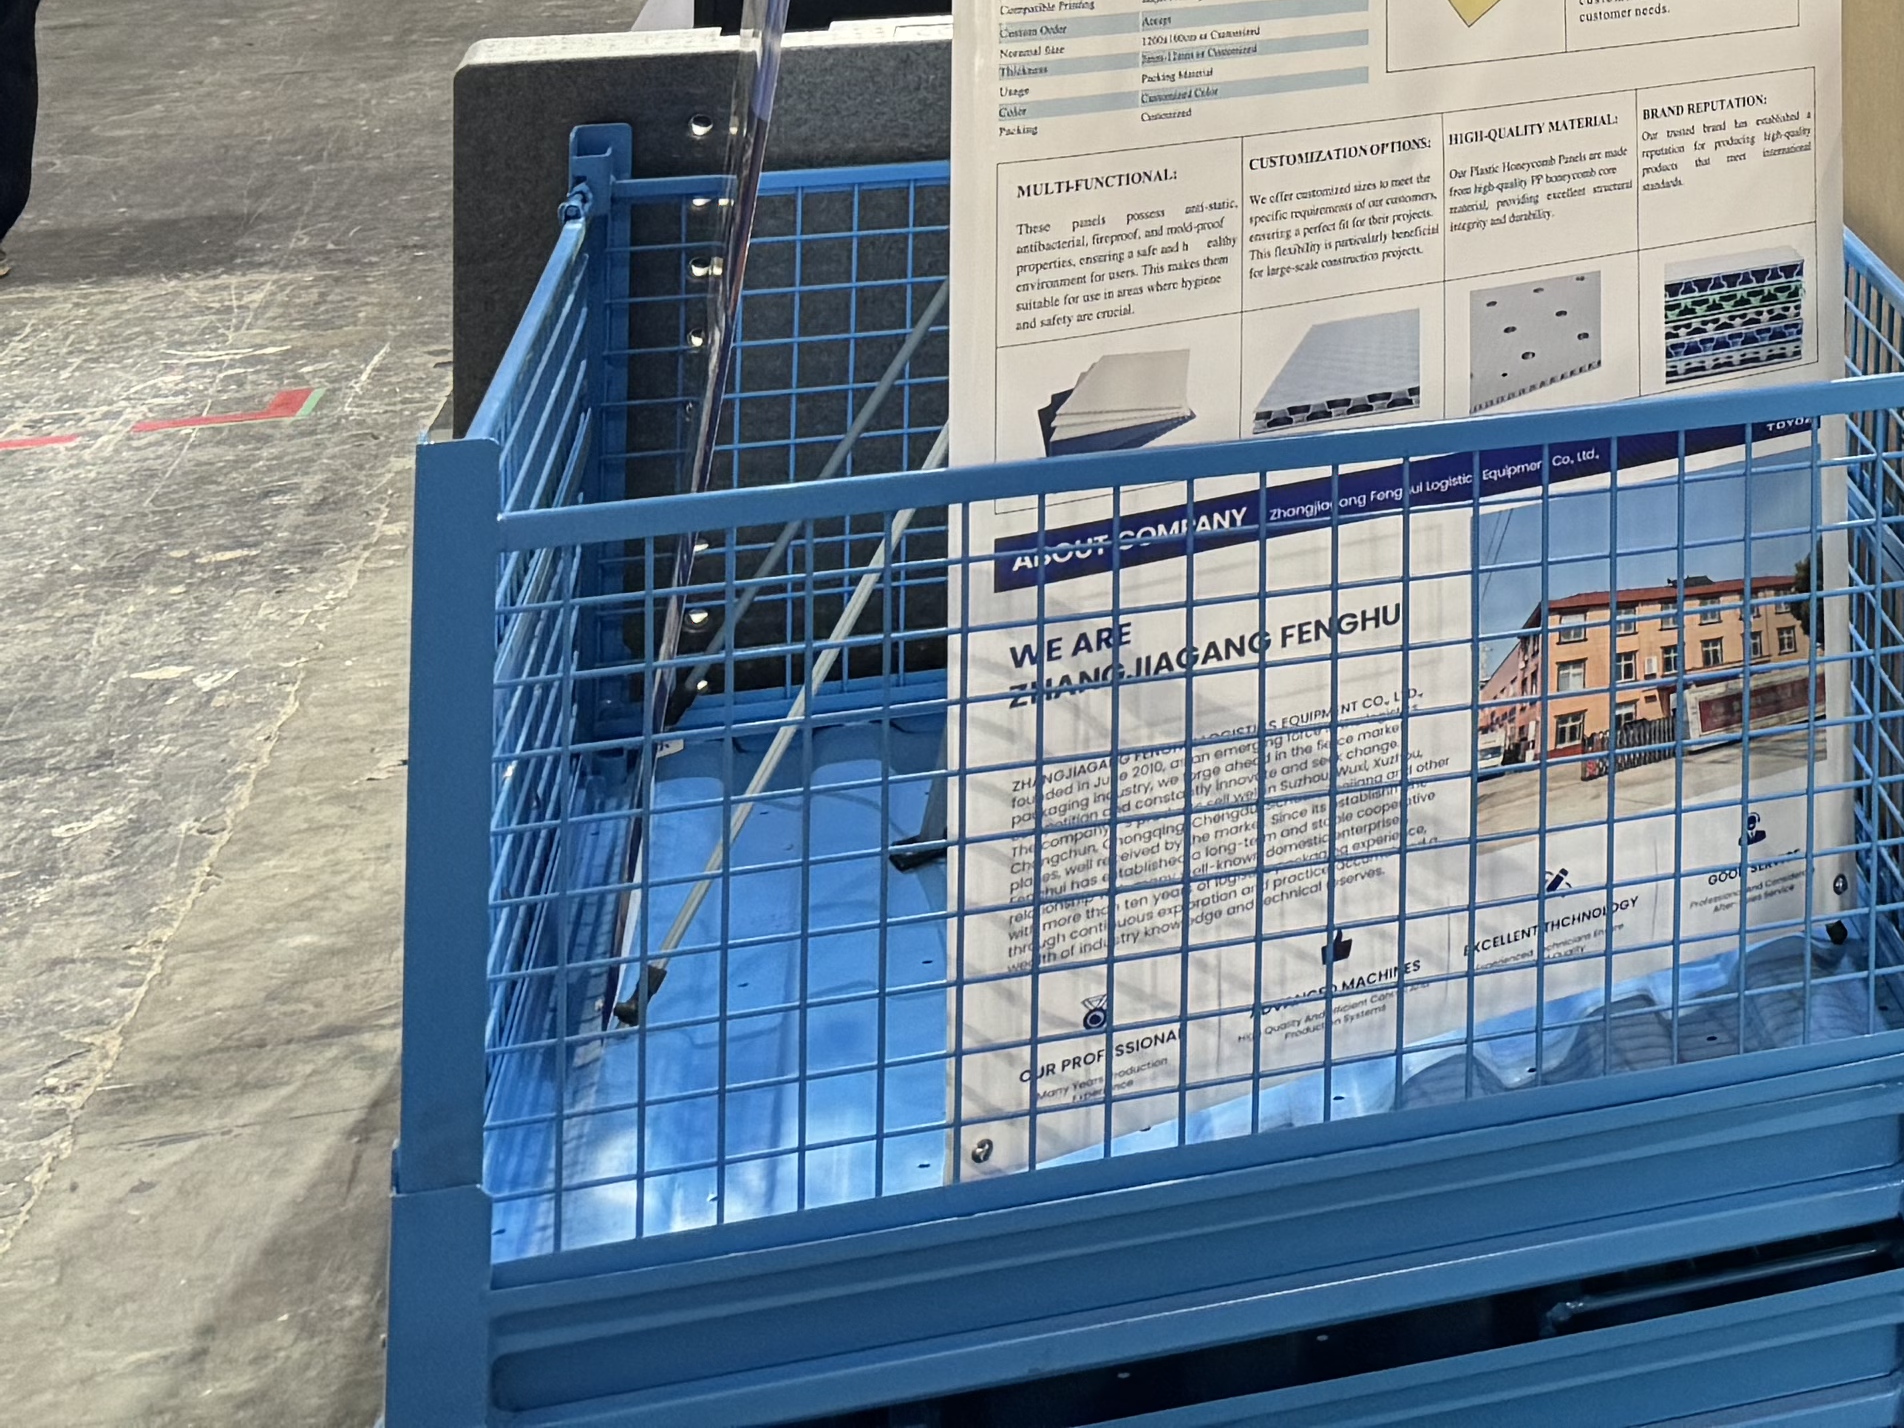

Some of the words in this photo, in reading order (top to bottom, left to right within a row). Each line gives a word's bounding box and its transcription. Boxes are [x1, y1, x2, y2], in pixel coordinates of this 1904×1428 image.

[1643, 105, 1684, 121] BRAND
[1688, 94, 1766, 115] REPUTATION:
[1449, 122, 1544, 146] HIGH-QUALITY
[1549, 113, 1617, 133] MATERIAL:
[1017, 168, 1176, 199] MULTI-FUNCTIONAL:
[1009, 637, 1064, 667] WE
[1071, 621, 1133, 656] ARE
